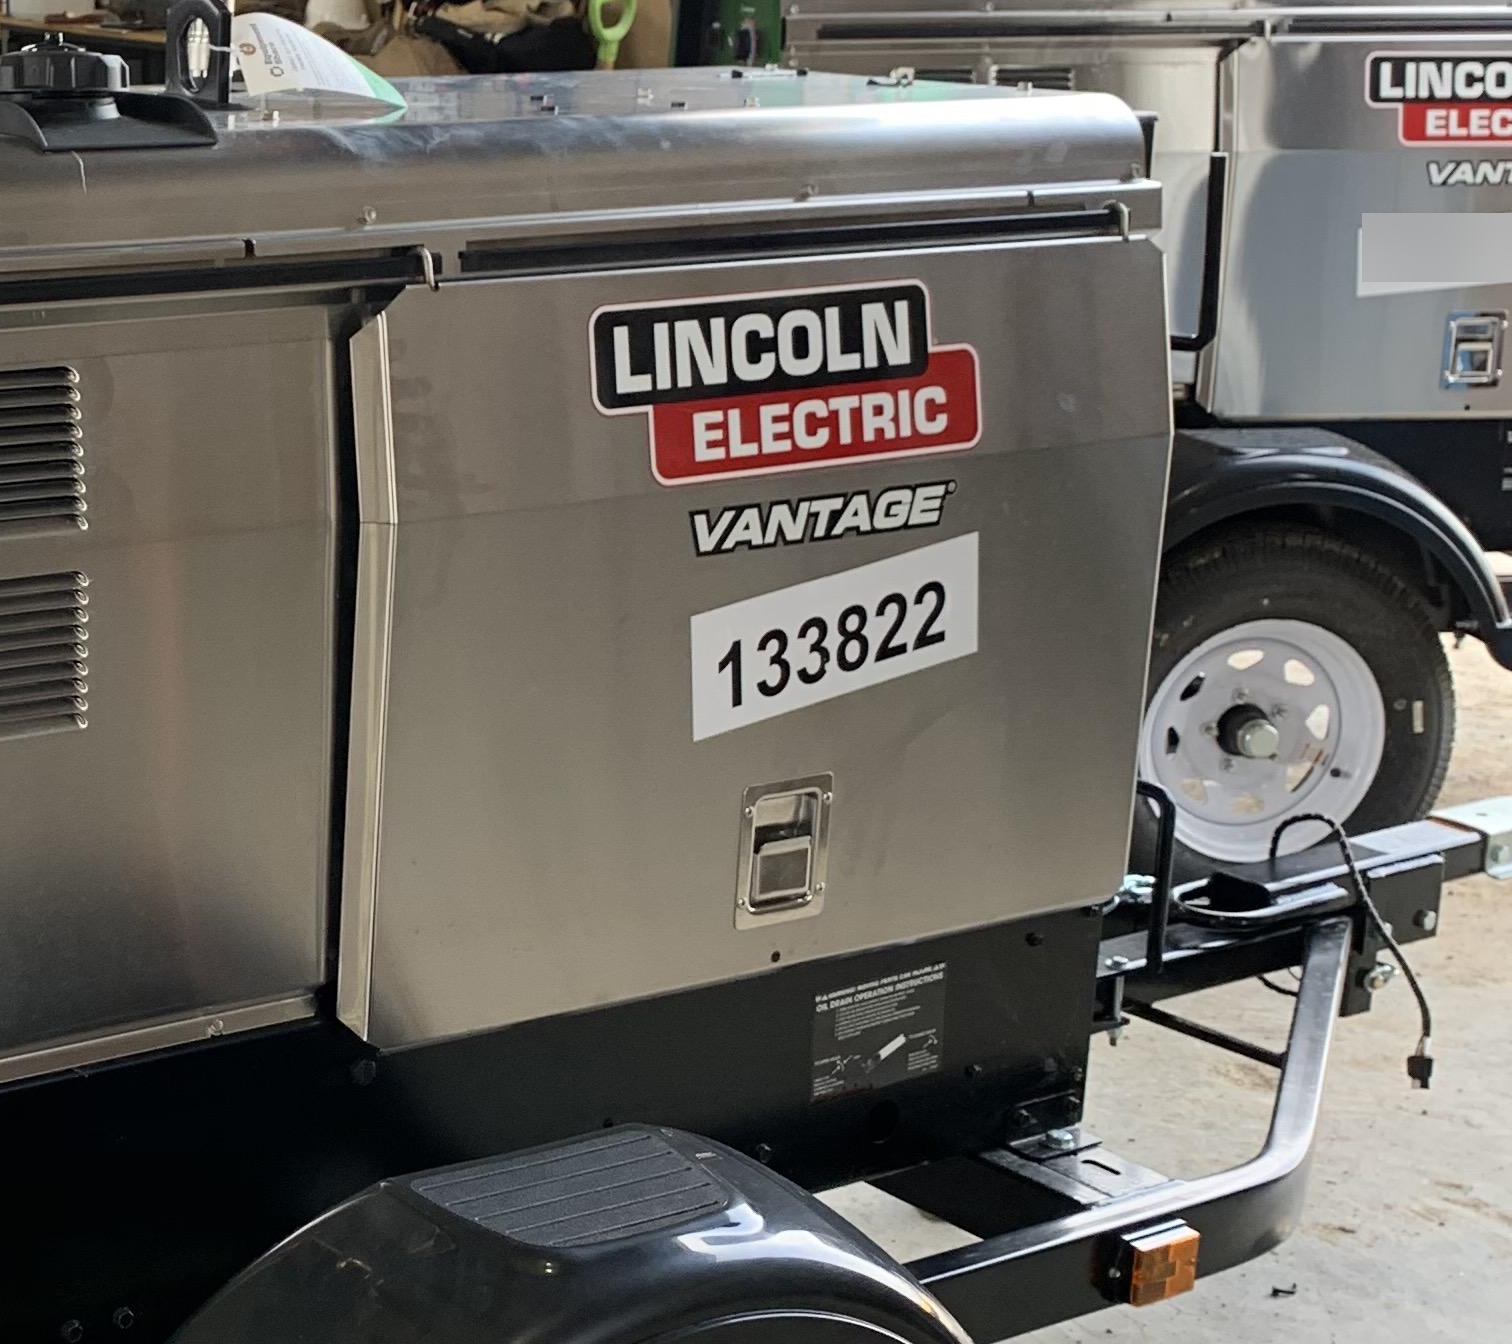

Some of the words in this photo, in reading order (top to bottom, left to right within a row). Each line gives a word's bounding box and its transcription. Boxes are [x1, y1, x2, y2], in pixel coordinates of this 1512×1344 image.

[613, 299, 911, 394] LINCOLN
[692, 386, 948, 463] ELECTRIC
[690, 485, 946, 557] VANTAGE
[717, 580, 947, 709] 133822
[854, 985, 894, 1002] OPERATION
[895, 971, 944, 991] INSTRUCTIONS
